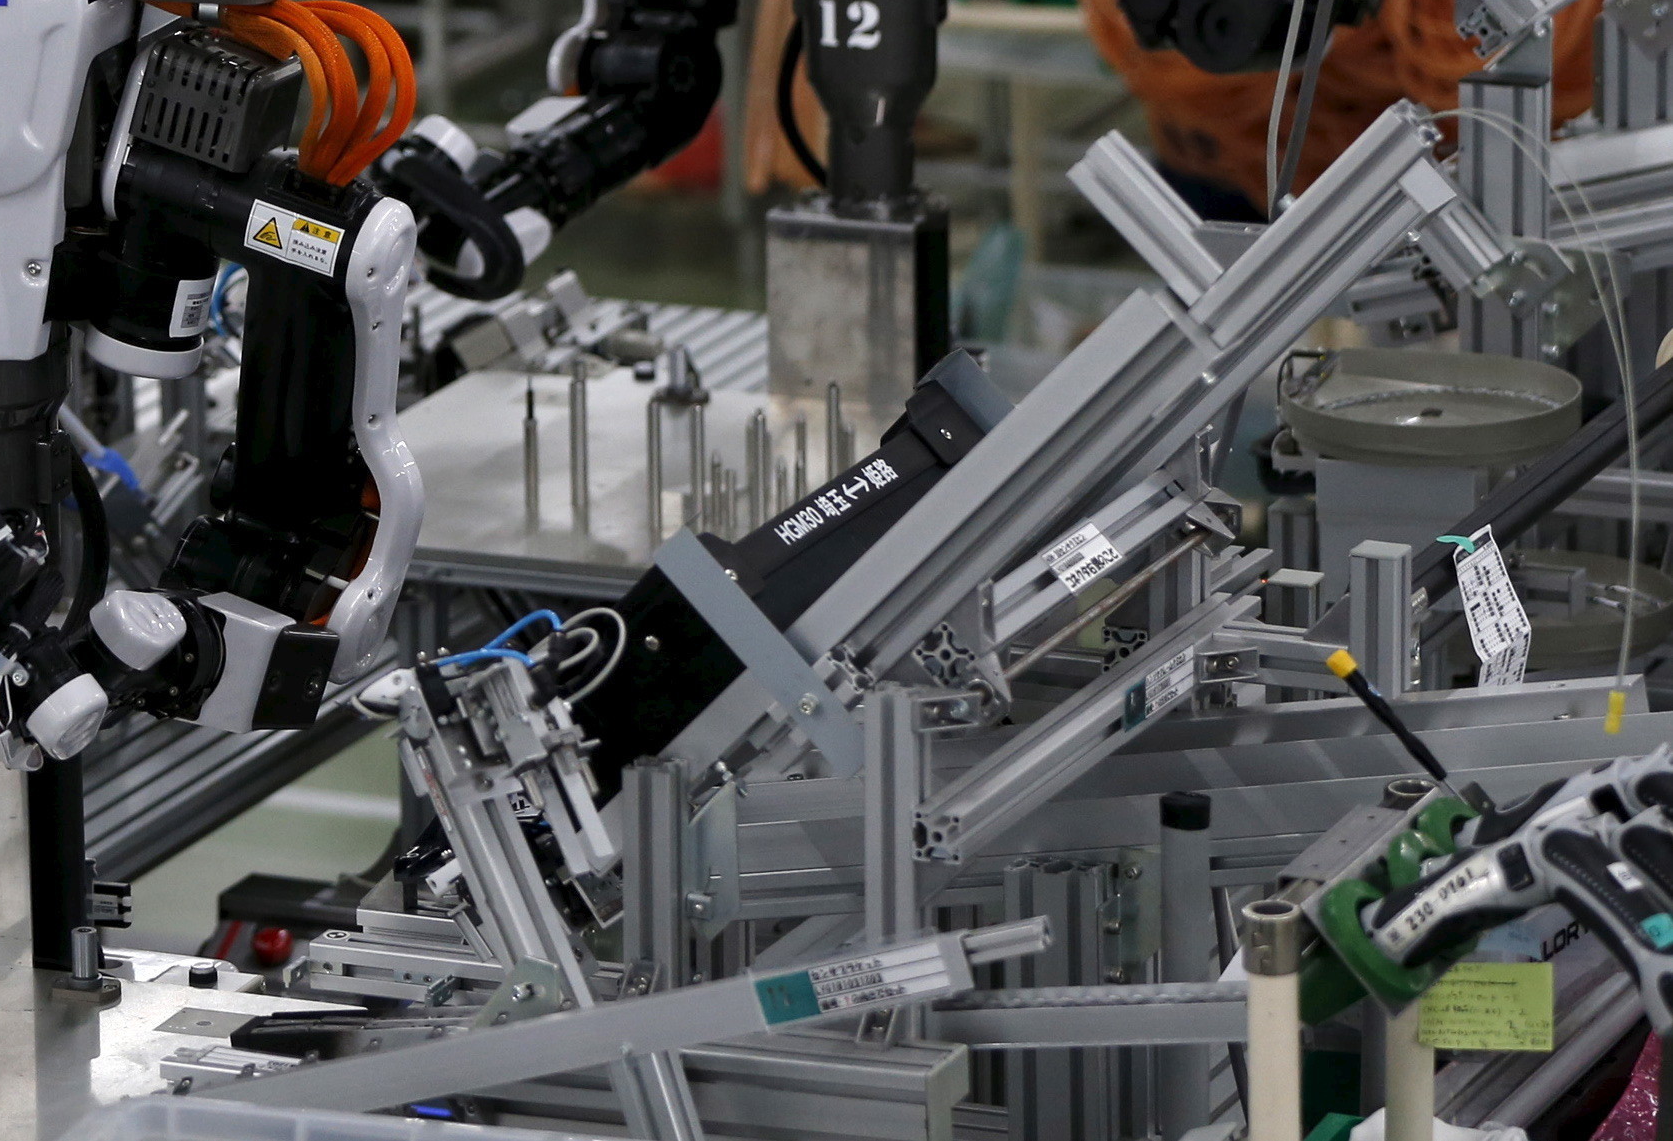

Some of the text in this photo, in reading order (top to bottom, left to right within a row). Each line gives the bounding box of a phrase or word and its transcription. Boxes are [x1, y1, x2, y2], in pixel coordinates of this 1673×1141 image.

[774, 458, 899, 545] HGM30 埼玉 姫路
